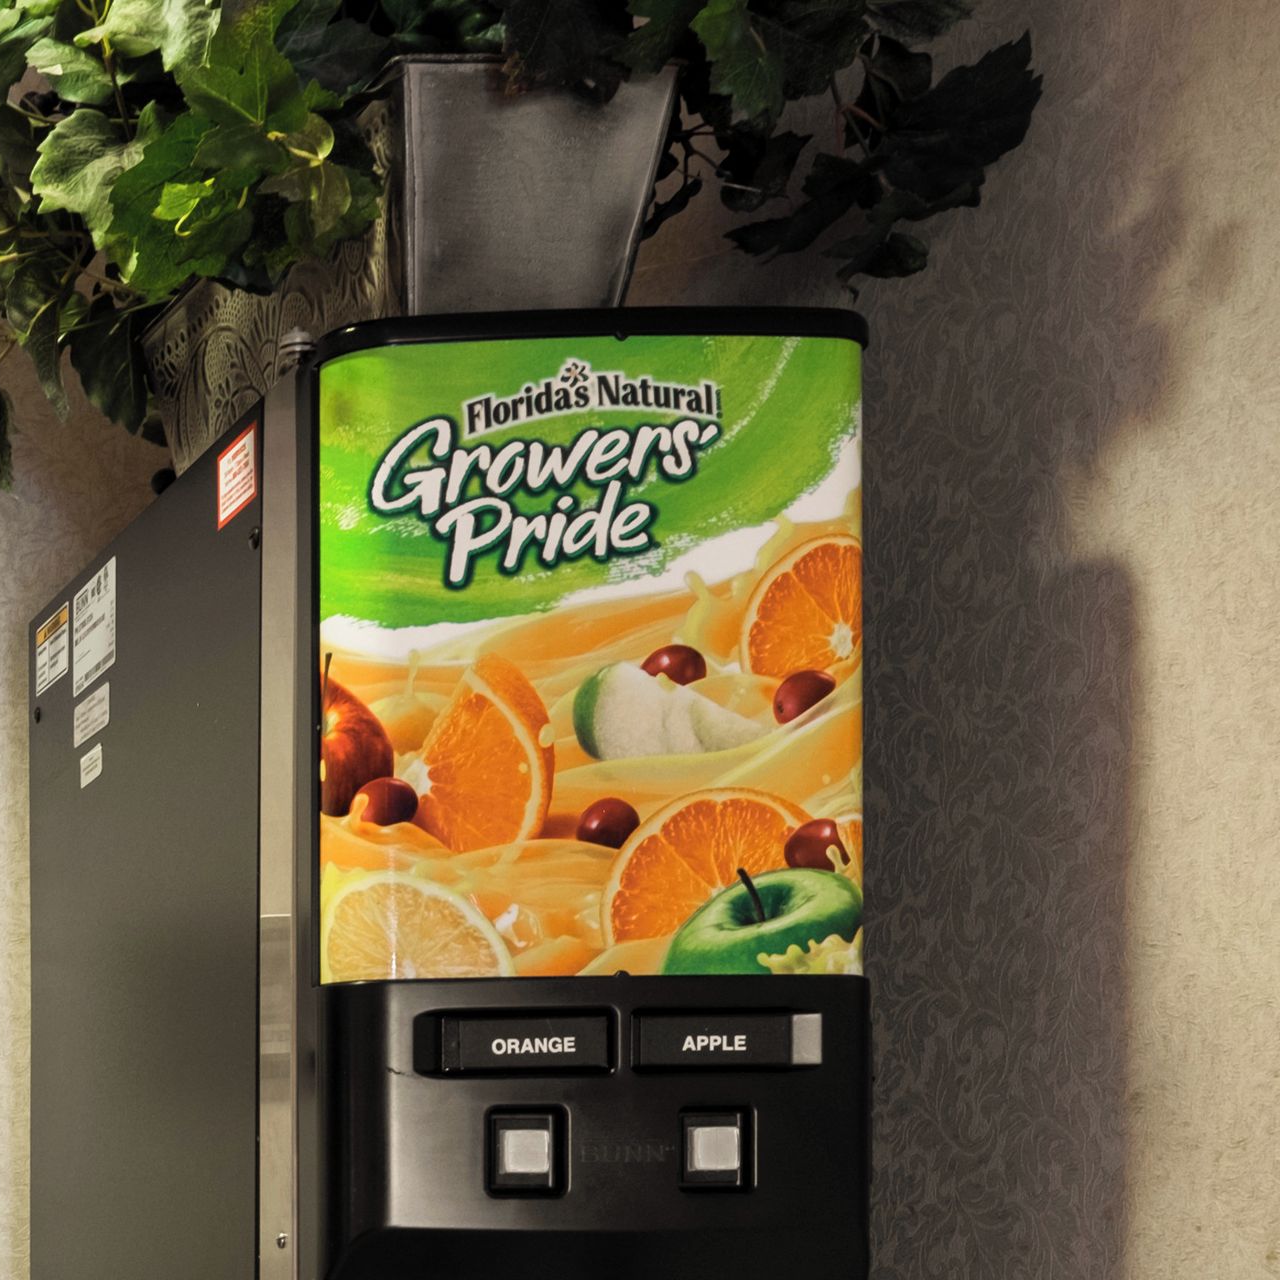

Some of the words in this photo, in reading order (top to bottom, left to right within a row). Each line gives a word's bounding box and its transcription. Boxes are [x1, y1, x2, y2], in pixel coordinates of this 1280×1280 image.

[597, 375, 713, 415] Natural
[437, 481, 652, 586] Pride
[491, 1035, 576, 1056] ORANGE
[682, 1034, 747, 1052] APPLE
